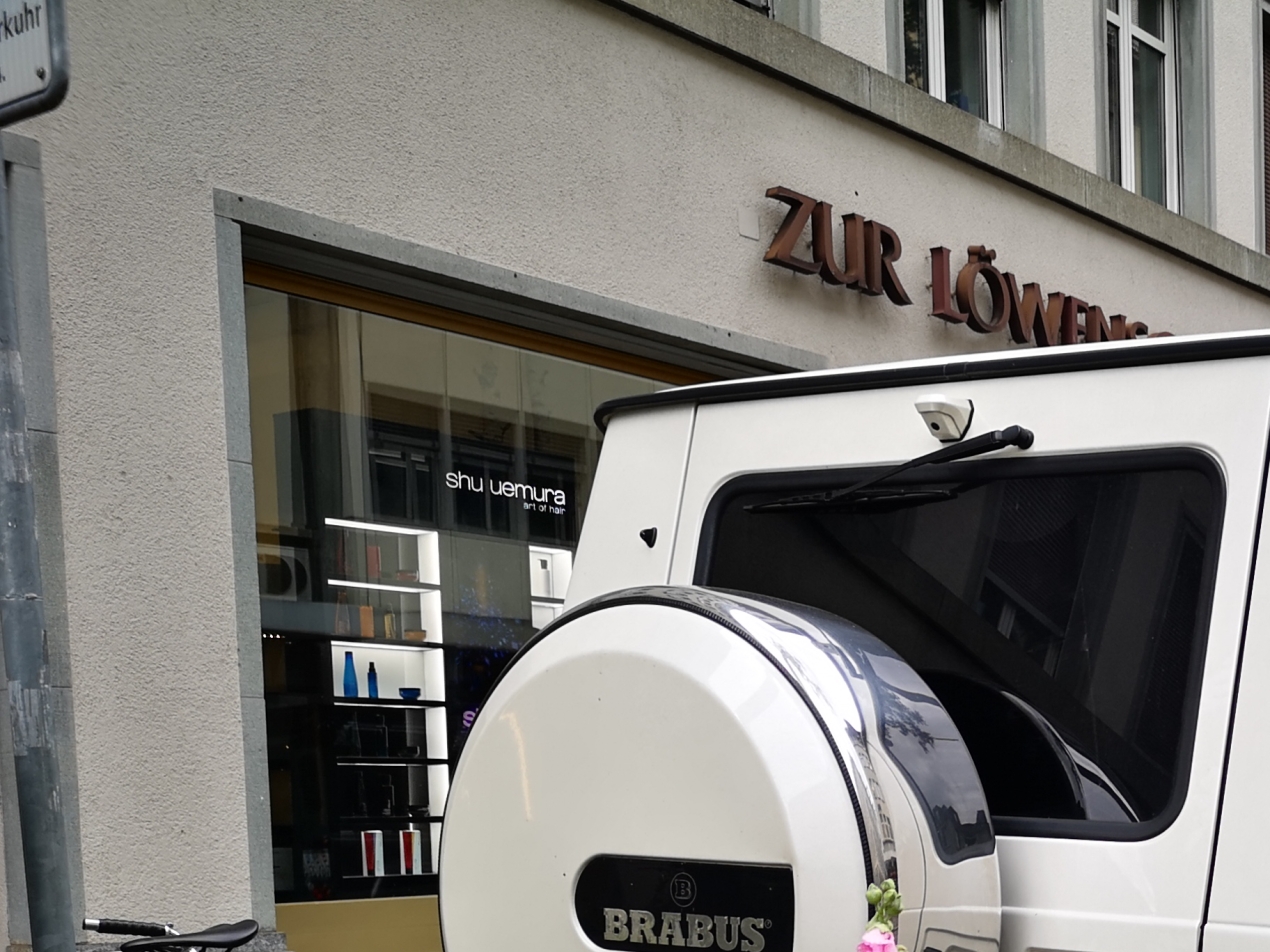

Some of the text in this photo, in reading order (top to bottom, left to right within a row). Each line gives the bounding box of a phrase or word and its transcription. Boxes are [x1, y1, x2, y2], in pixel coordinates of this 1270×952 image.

[763, 186, 1174, 346] ZUR LÖWEN
[445, 471, 566, 506] shu uemura
[523, 502, 566, 515] art of hair
